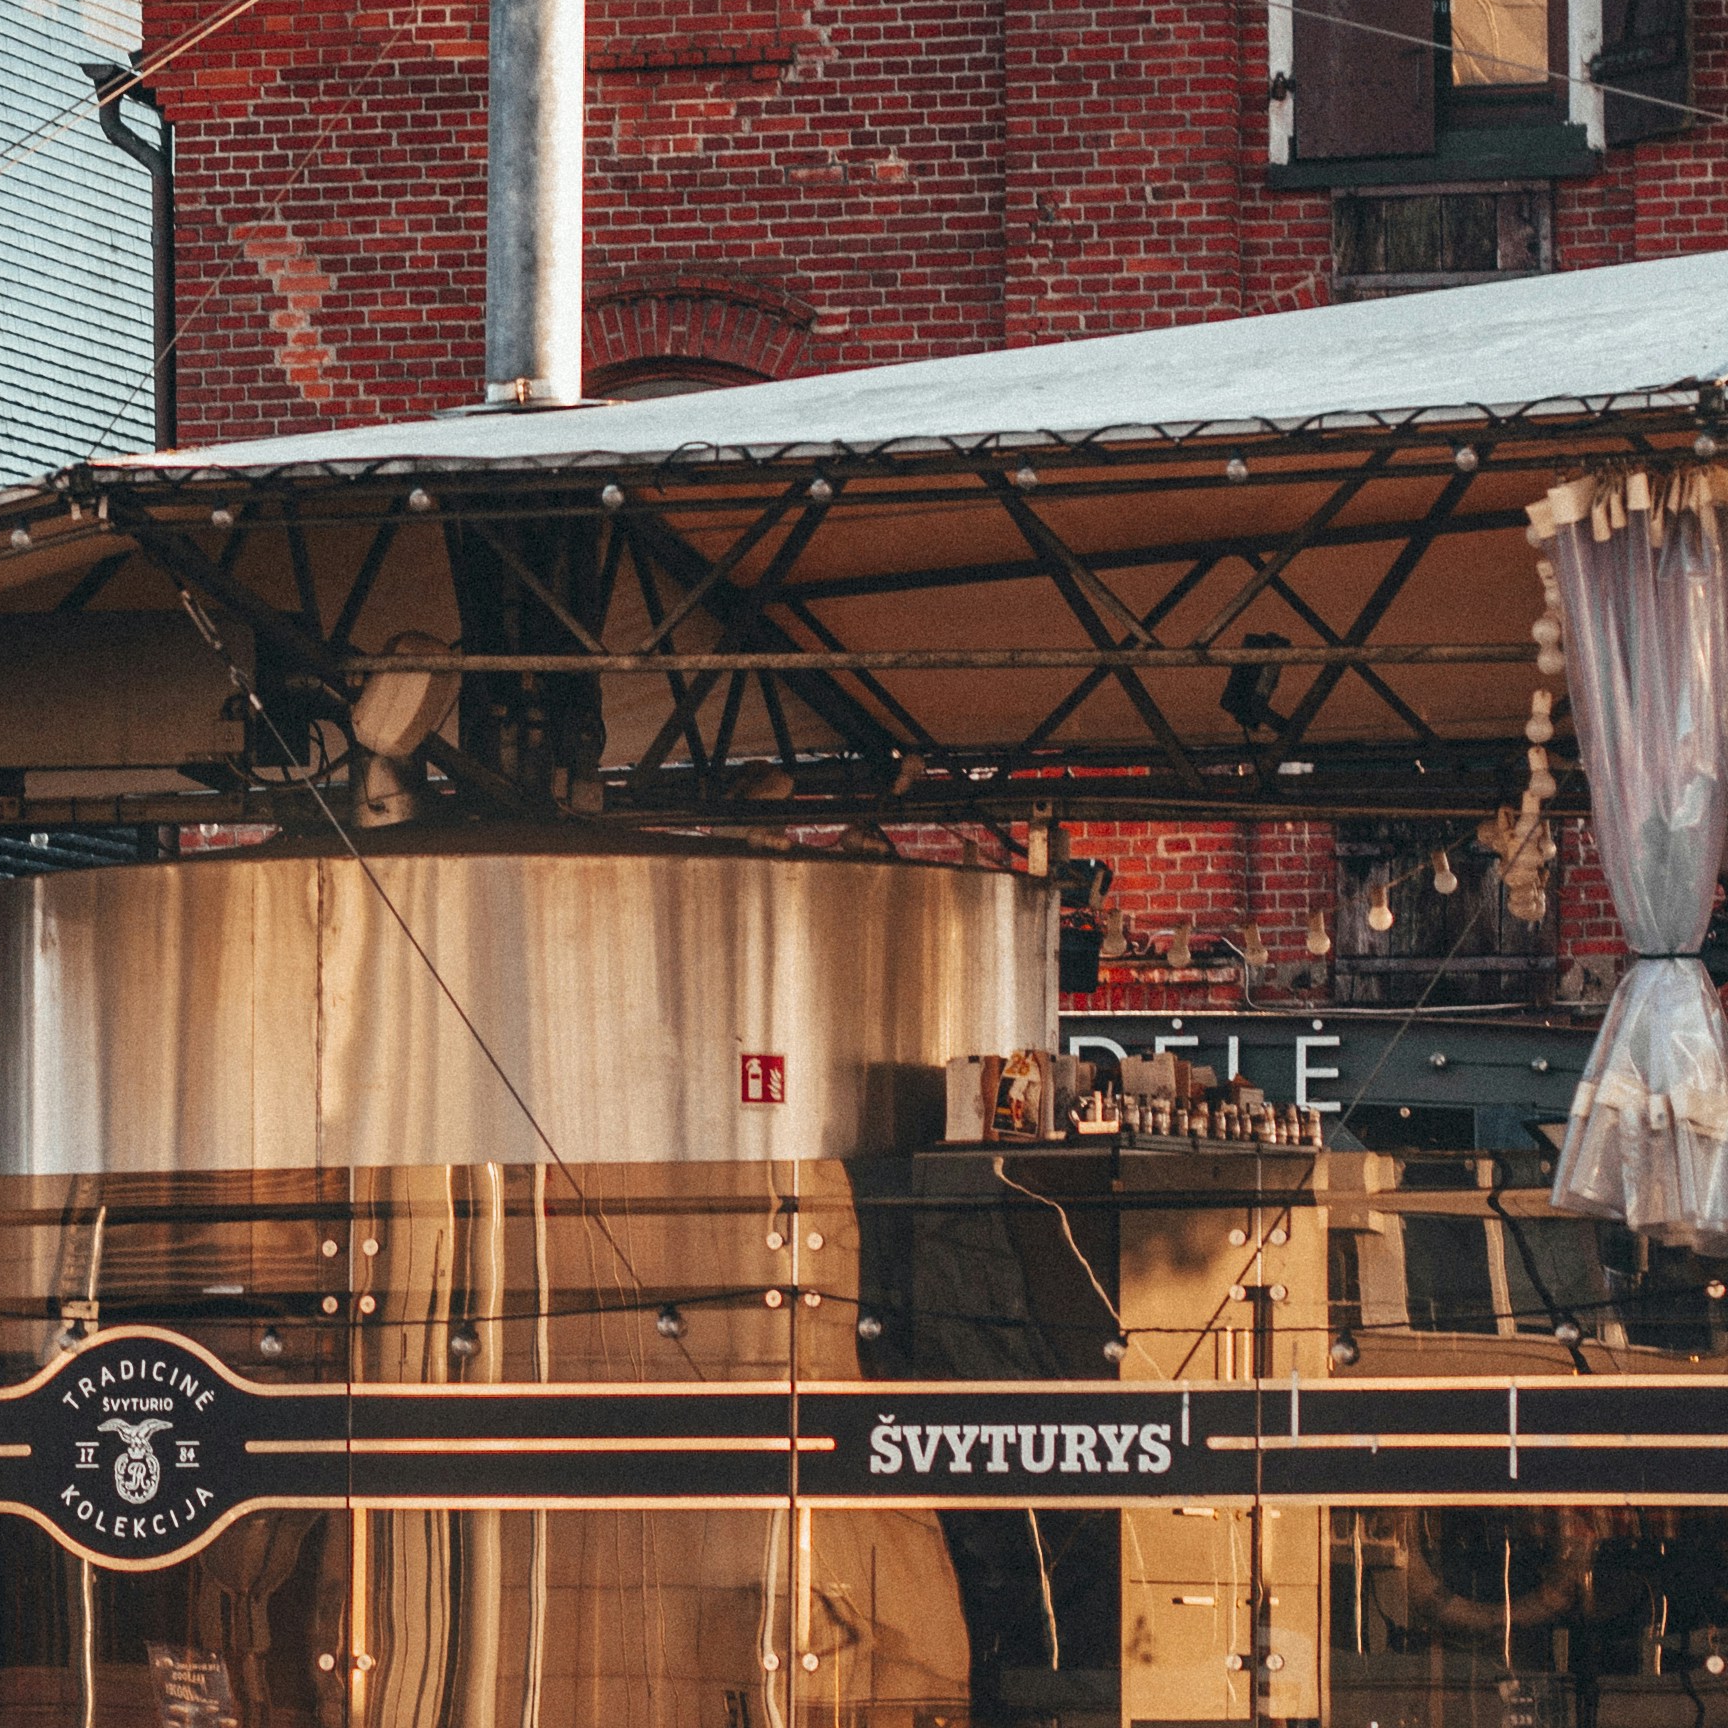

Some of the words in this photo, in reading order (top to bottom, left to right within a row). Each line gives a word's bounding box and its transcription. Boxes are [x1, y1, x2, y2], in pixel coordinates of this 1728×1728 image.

[62, 1359, 215, 1412] TRADICINĖ
[80, 1447, 95, 1463] 17
[178, 1446, 196, 1463] 84
[870, 1414, 1172, 1474] ŠVYTURYS
[60, 1484, 214, 1538] KOLEKCIJA
